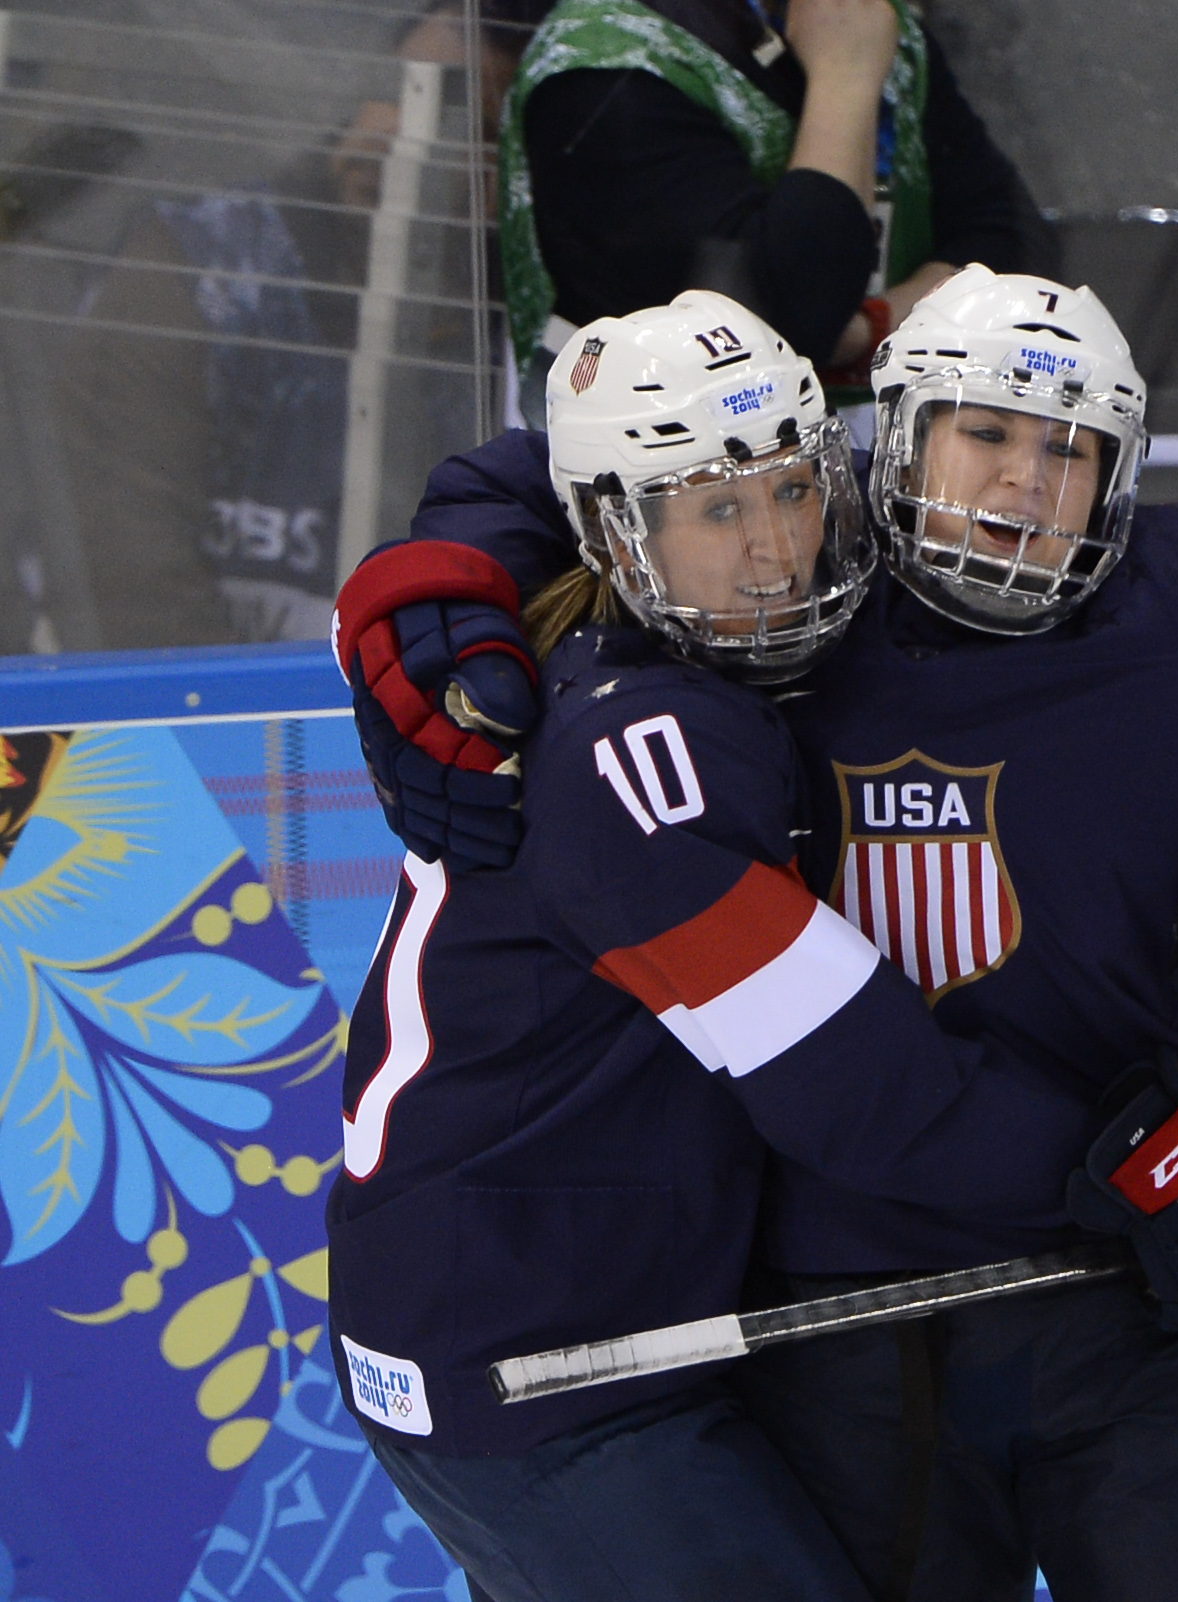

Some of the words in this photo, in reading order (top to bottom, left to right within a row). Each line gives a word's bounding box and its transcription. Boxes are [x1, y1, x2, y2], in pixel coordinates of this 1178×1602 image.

[1037, 290, 1059, 313] 7
[1020, 347, 1077, 369] sochi.ru
[1025, 358, 1056, 377] 2014
[721, 382, 774, 408] sochi.ru
[730, 397, 761, 415] 2014
[593, 713, 706, 836] 10
[863, 782, 971, 827] USA
[1128, 1126, 1146, 1146] USA
[348, 1350, 411, 1396] sochi.ru
